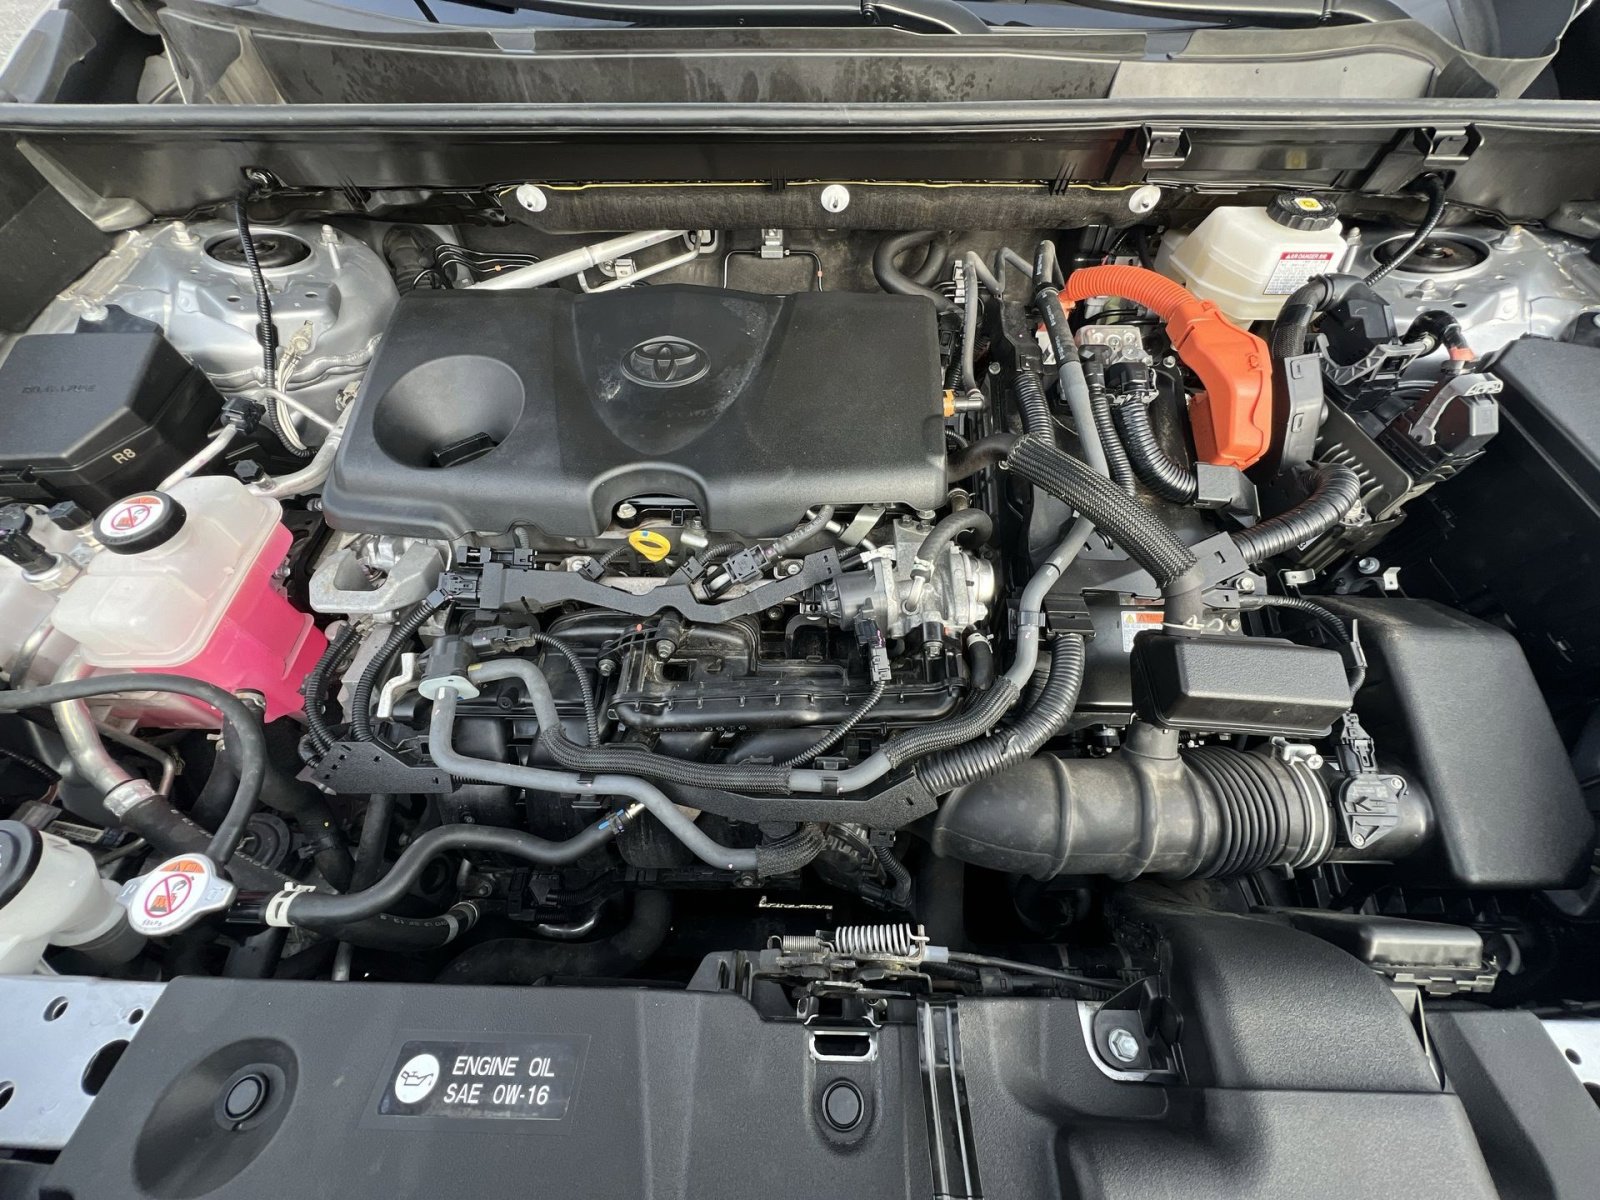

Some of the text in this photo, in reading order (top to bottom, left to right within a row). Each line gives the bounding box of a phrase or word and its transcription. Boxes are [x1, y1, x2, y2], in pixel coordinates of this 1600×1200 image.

[112, 448, 136, 464] R8
[452, 1056, 555, 1077] ENGINE OIL
[443, 1083, 550, 1105] SAE 0W-16
